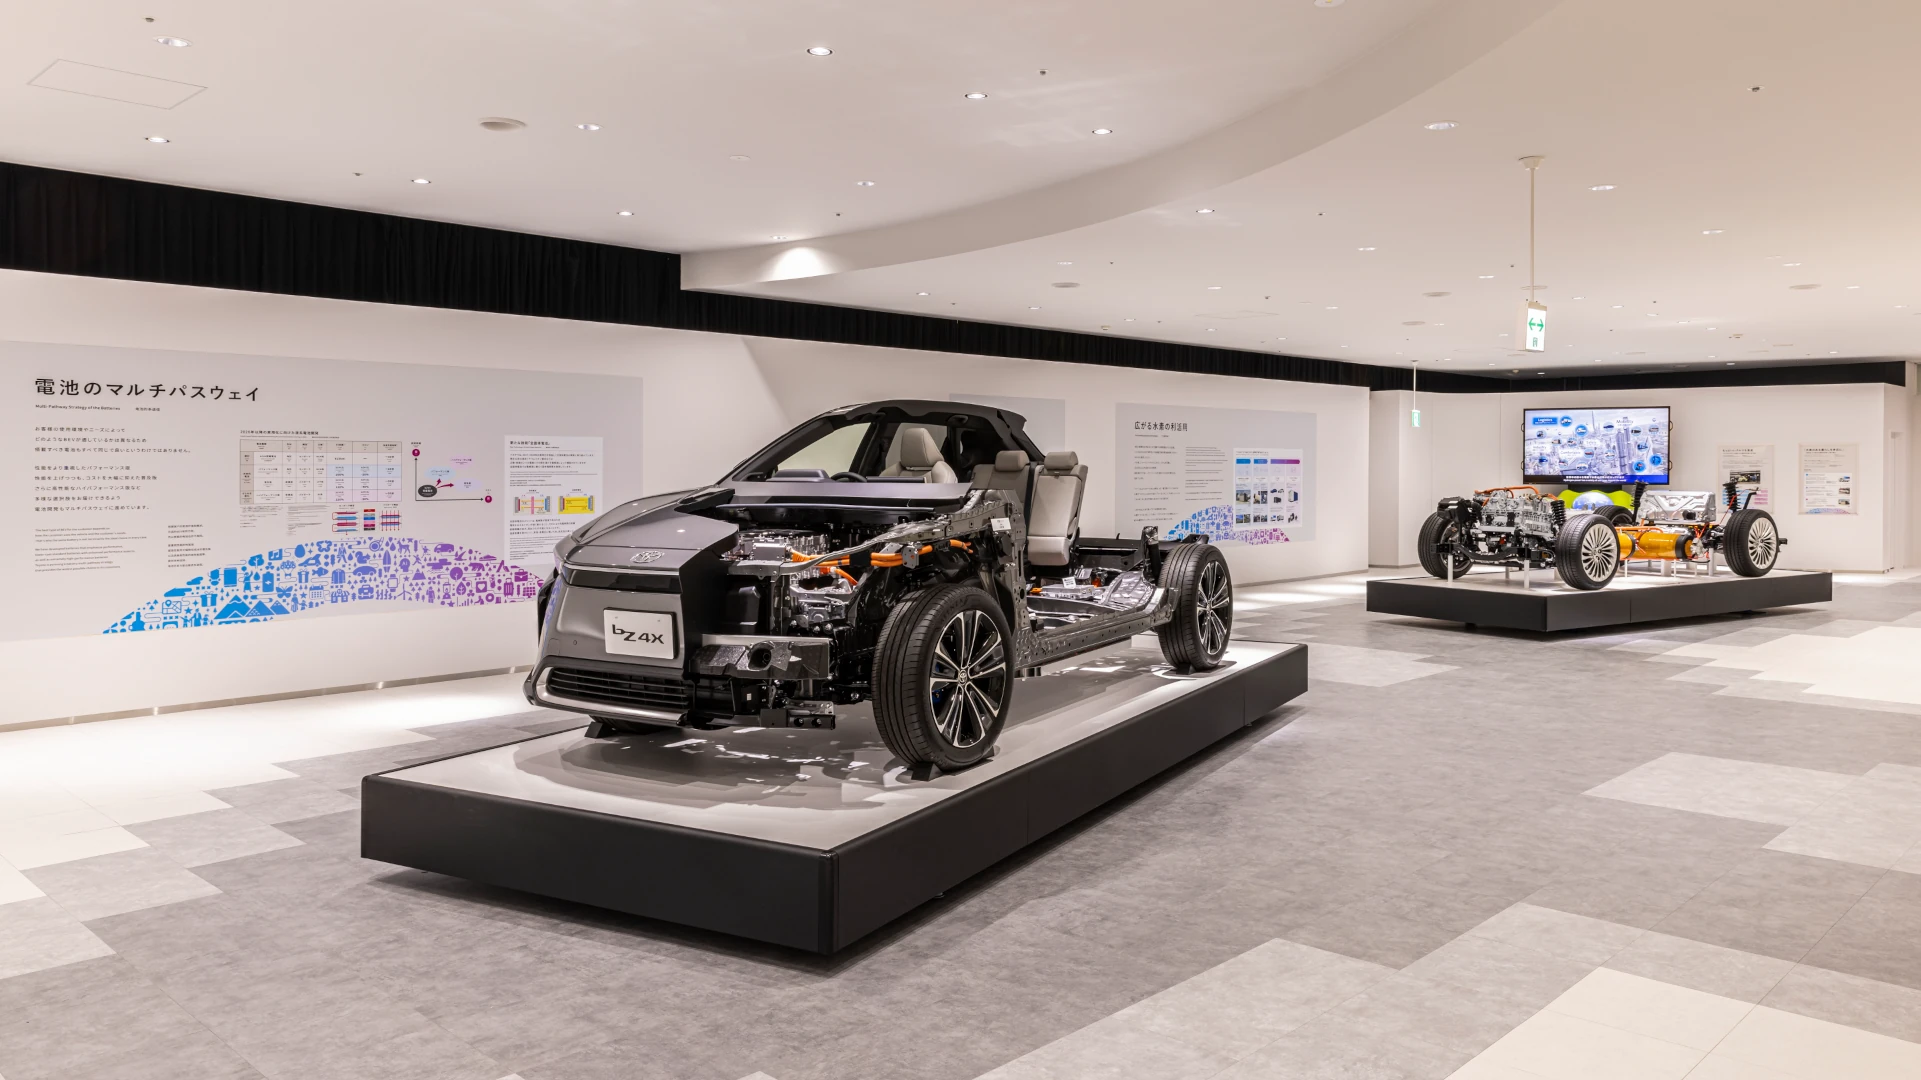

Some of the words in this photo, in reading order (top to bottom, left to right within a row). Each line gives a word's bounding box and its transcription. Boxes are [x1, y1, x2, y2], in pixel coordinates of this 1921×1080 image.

[34, 378, 259, 402] 電池のマルチパスウェイ
[1134, 420, 1188, 432] 広がる水素の利活用
[612, 624, 664, 644] bZ4X
